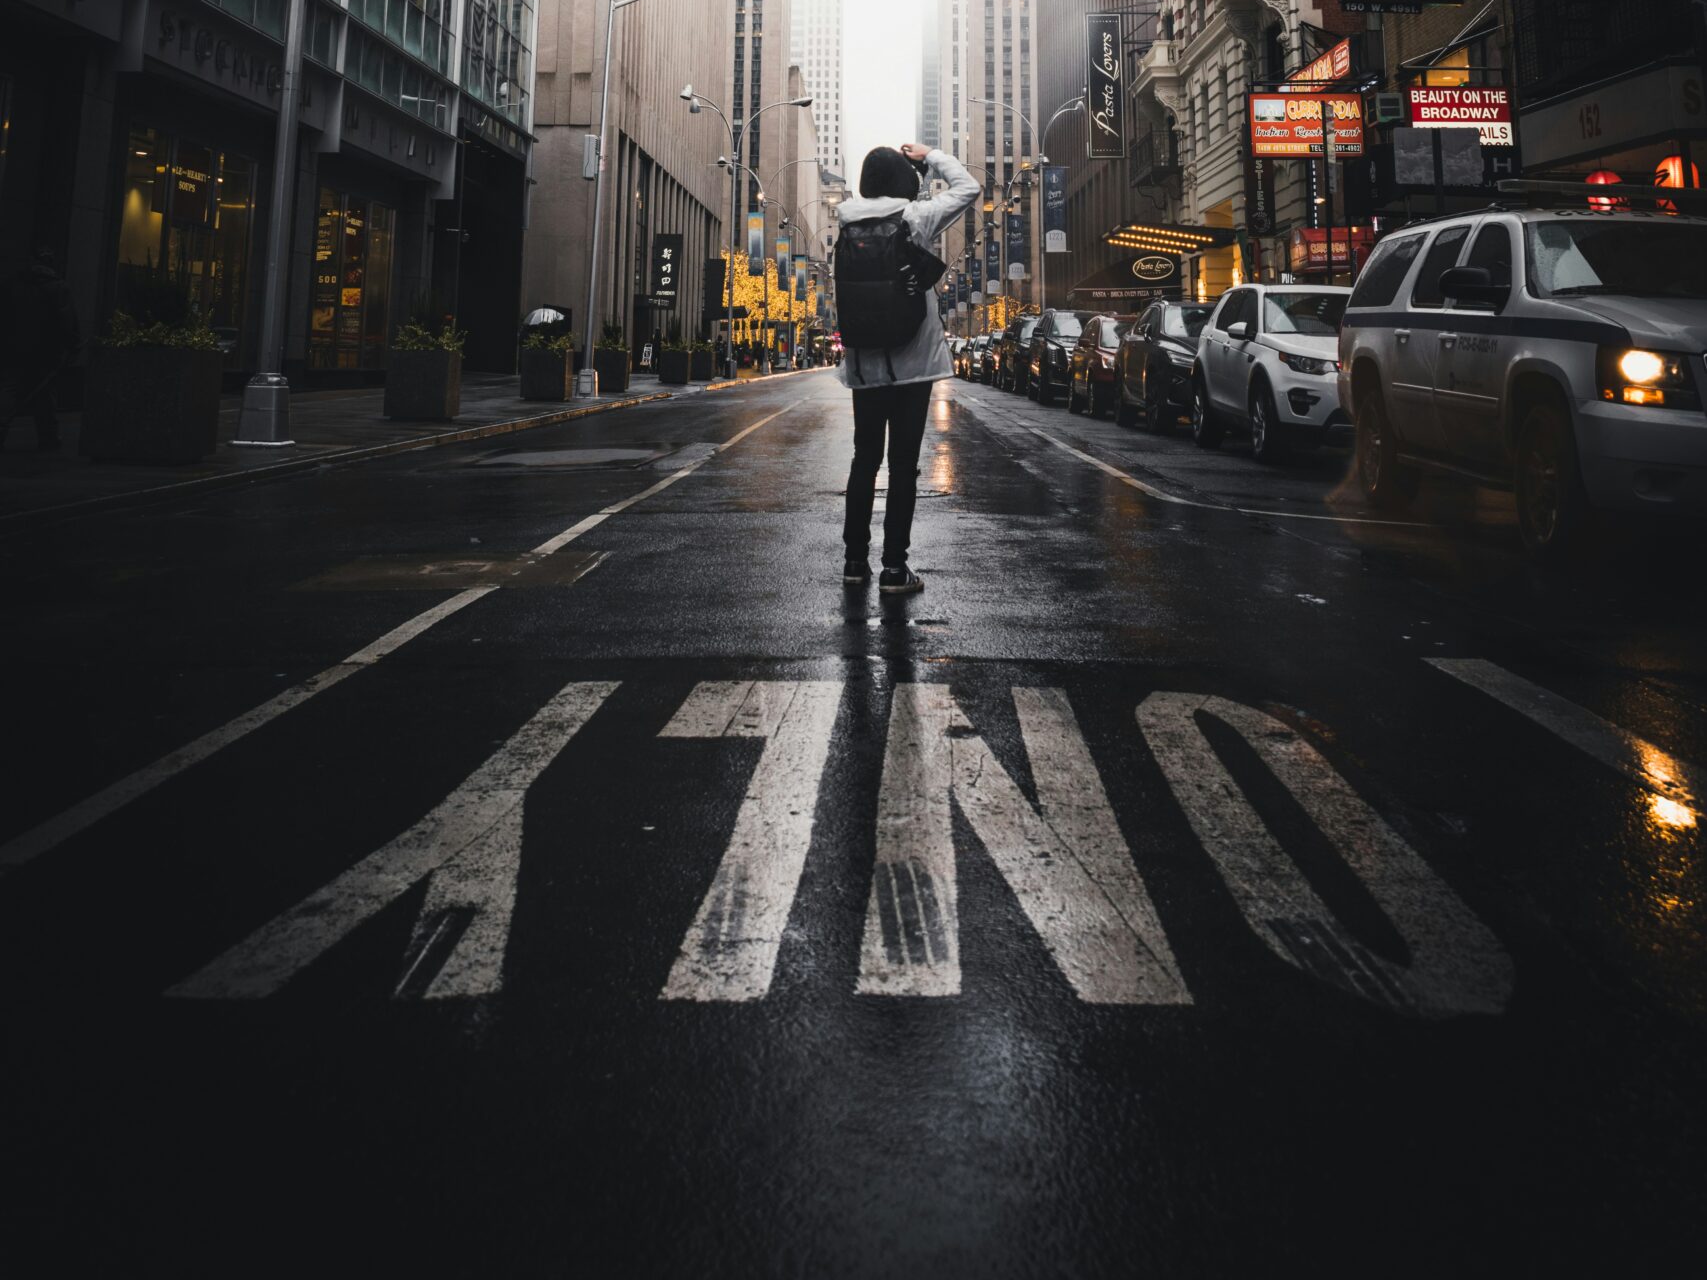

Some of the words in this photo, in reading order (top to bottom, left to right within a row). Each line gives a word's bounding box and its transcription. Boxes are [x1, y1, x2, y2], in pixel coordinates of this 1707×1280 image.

[1345, 2, 1365, 12] 150
[1371, 3, 1385, 12] W.
[1091, 32, 1119, 82] Lovers
[1410, 90, 1460, 104] BEAUTY
[1462, 90, 1481, 104] ON
[1482, 90, 1508, 104] THE
[1091, 84, 1119, 138] Pasta
[1328, 100, 1361, 120] NDIA
[1420, 107, 1499, 119] BROADWAY
[1578, 103, 1602, 139] 152
[1255, 126, 1289, 137] Indian
[1479, 126, 1509, 139] AILS
[160, 678, 1518, 1018] ONLY
